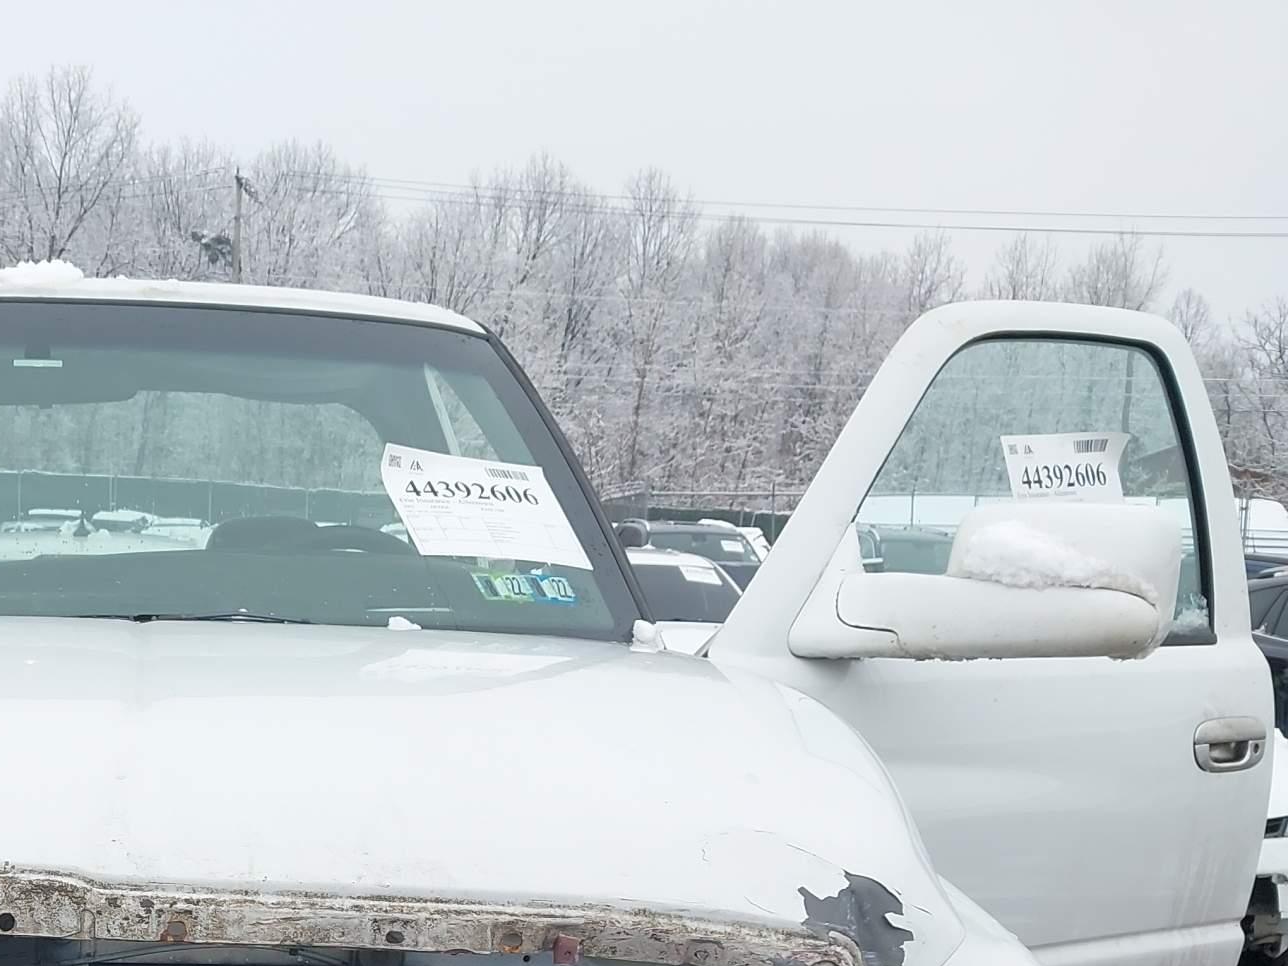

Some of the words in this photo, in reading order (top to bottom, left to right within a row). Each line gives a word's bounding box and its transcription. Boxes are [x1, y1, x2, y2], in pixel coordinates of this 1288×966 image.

[1021, 462, 1107, 489] 44392606
[405, 480, 539, 506] 44392606
[505, 577, 526, 596] 22
[551, 579, 573, 598] 22
